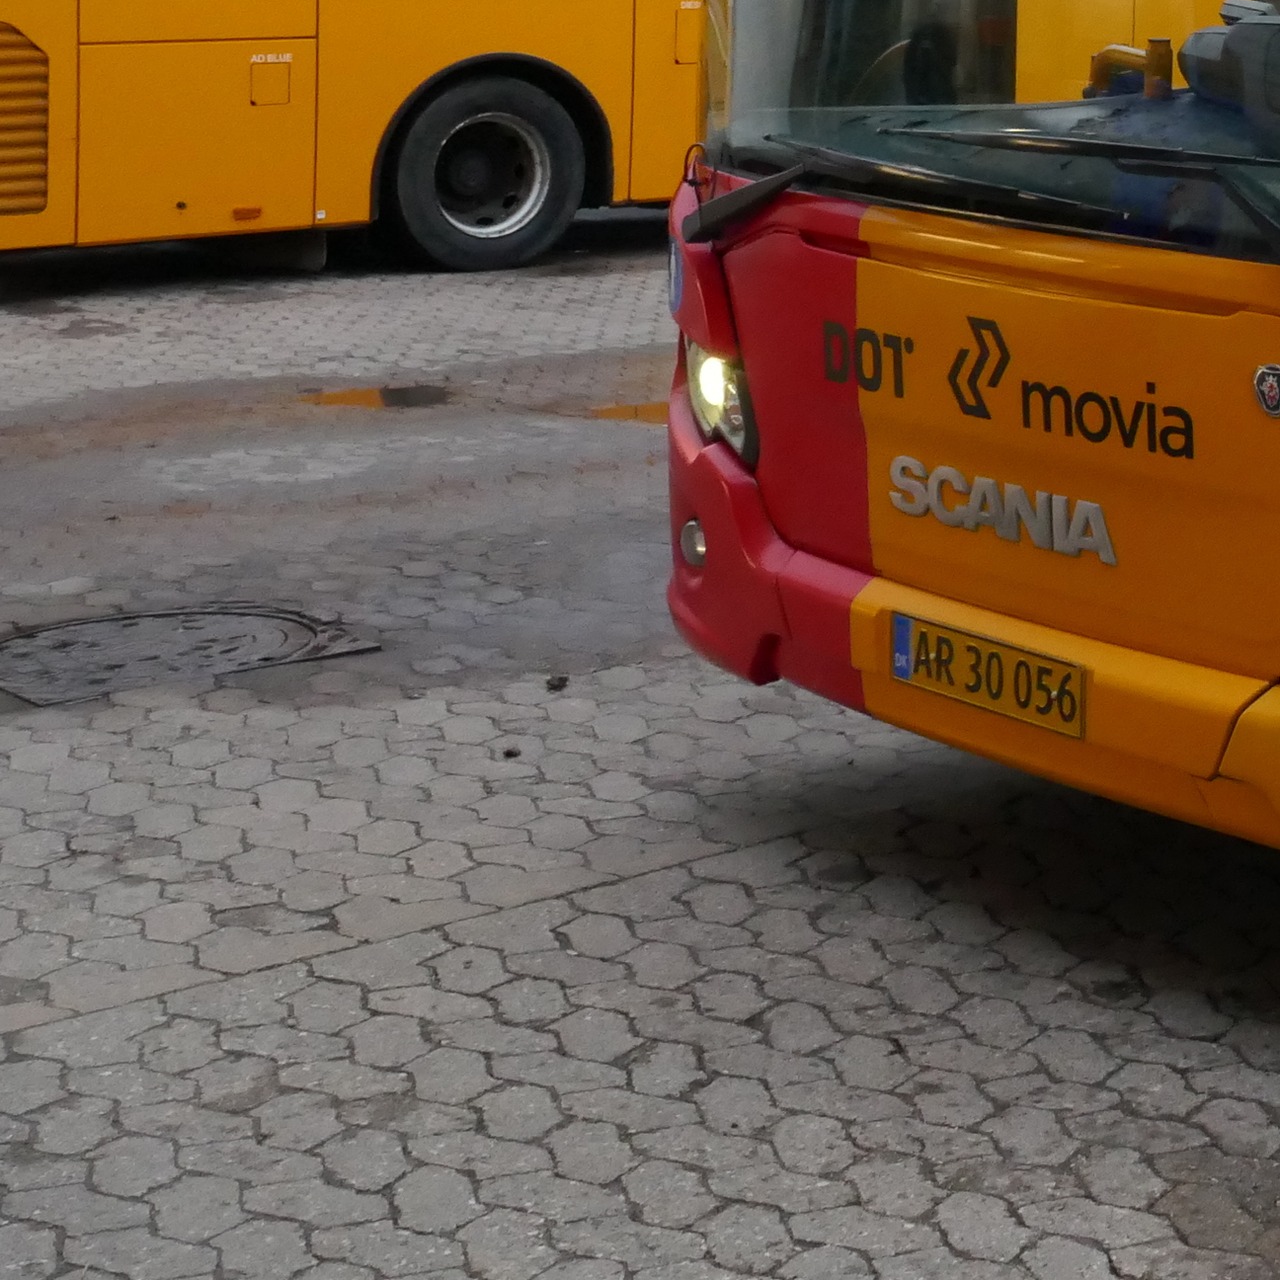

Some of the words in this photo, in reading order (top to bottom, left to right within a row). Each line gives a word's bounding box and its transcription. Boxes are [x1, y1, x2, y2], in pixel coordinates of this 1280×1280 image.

[823, 321, 915, 399] DOT
[1021, 380, 1195, 459] movia
[889, 455, 1118, 566] SCANIA
[913, 629, 956, 686] AR
[965, 643, 1004, 700] 30
[1014, 659, 1078, 723] 056
